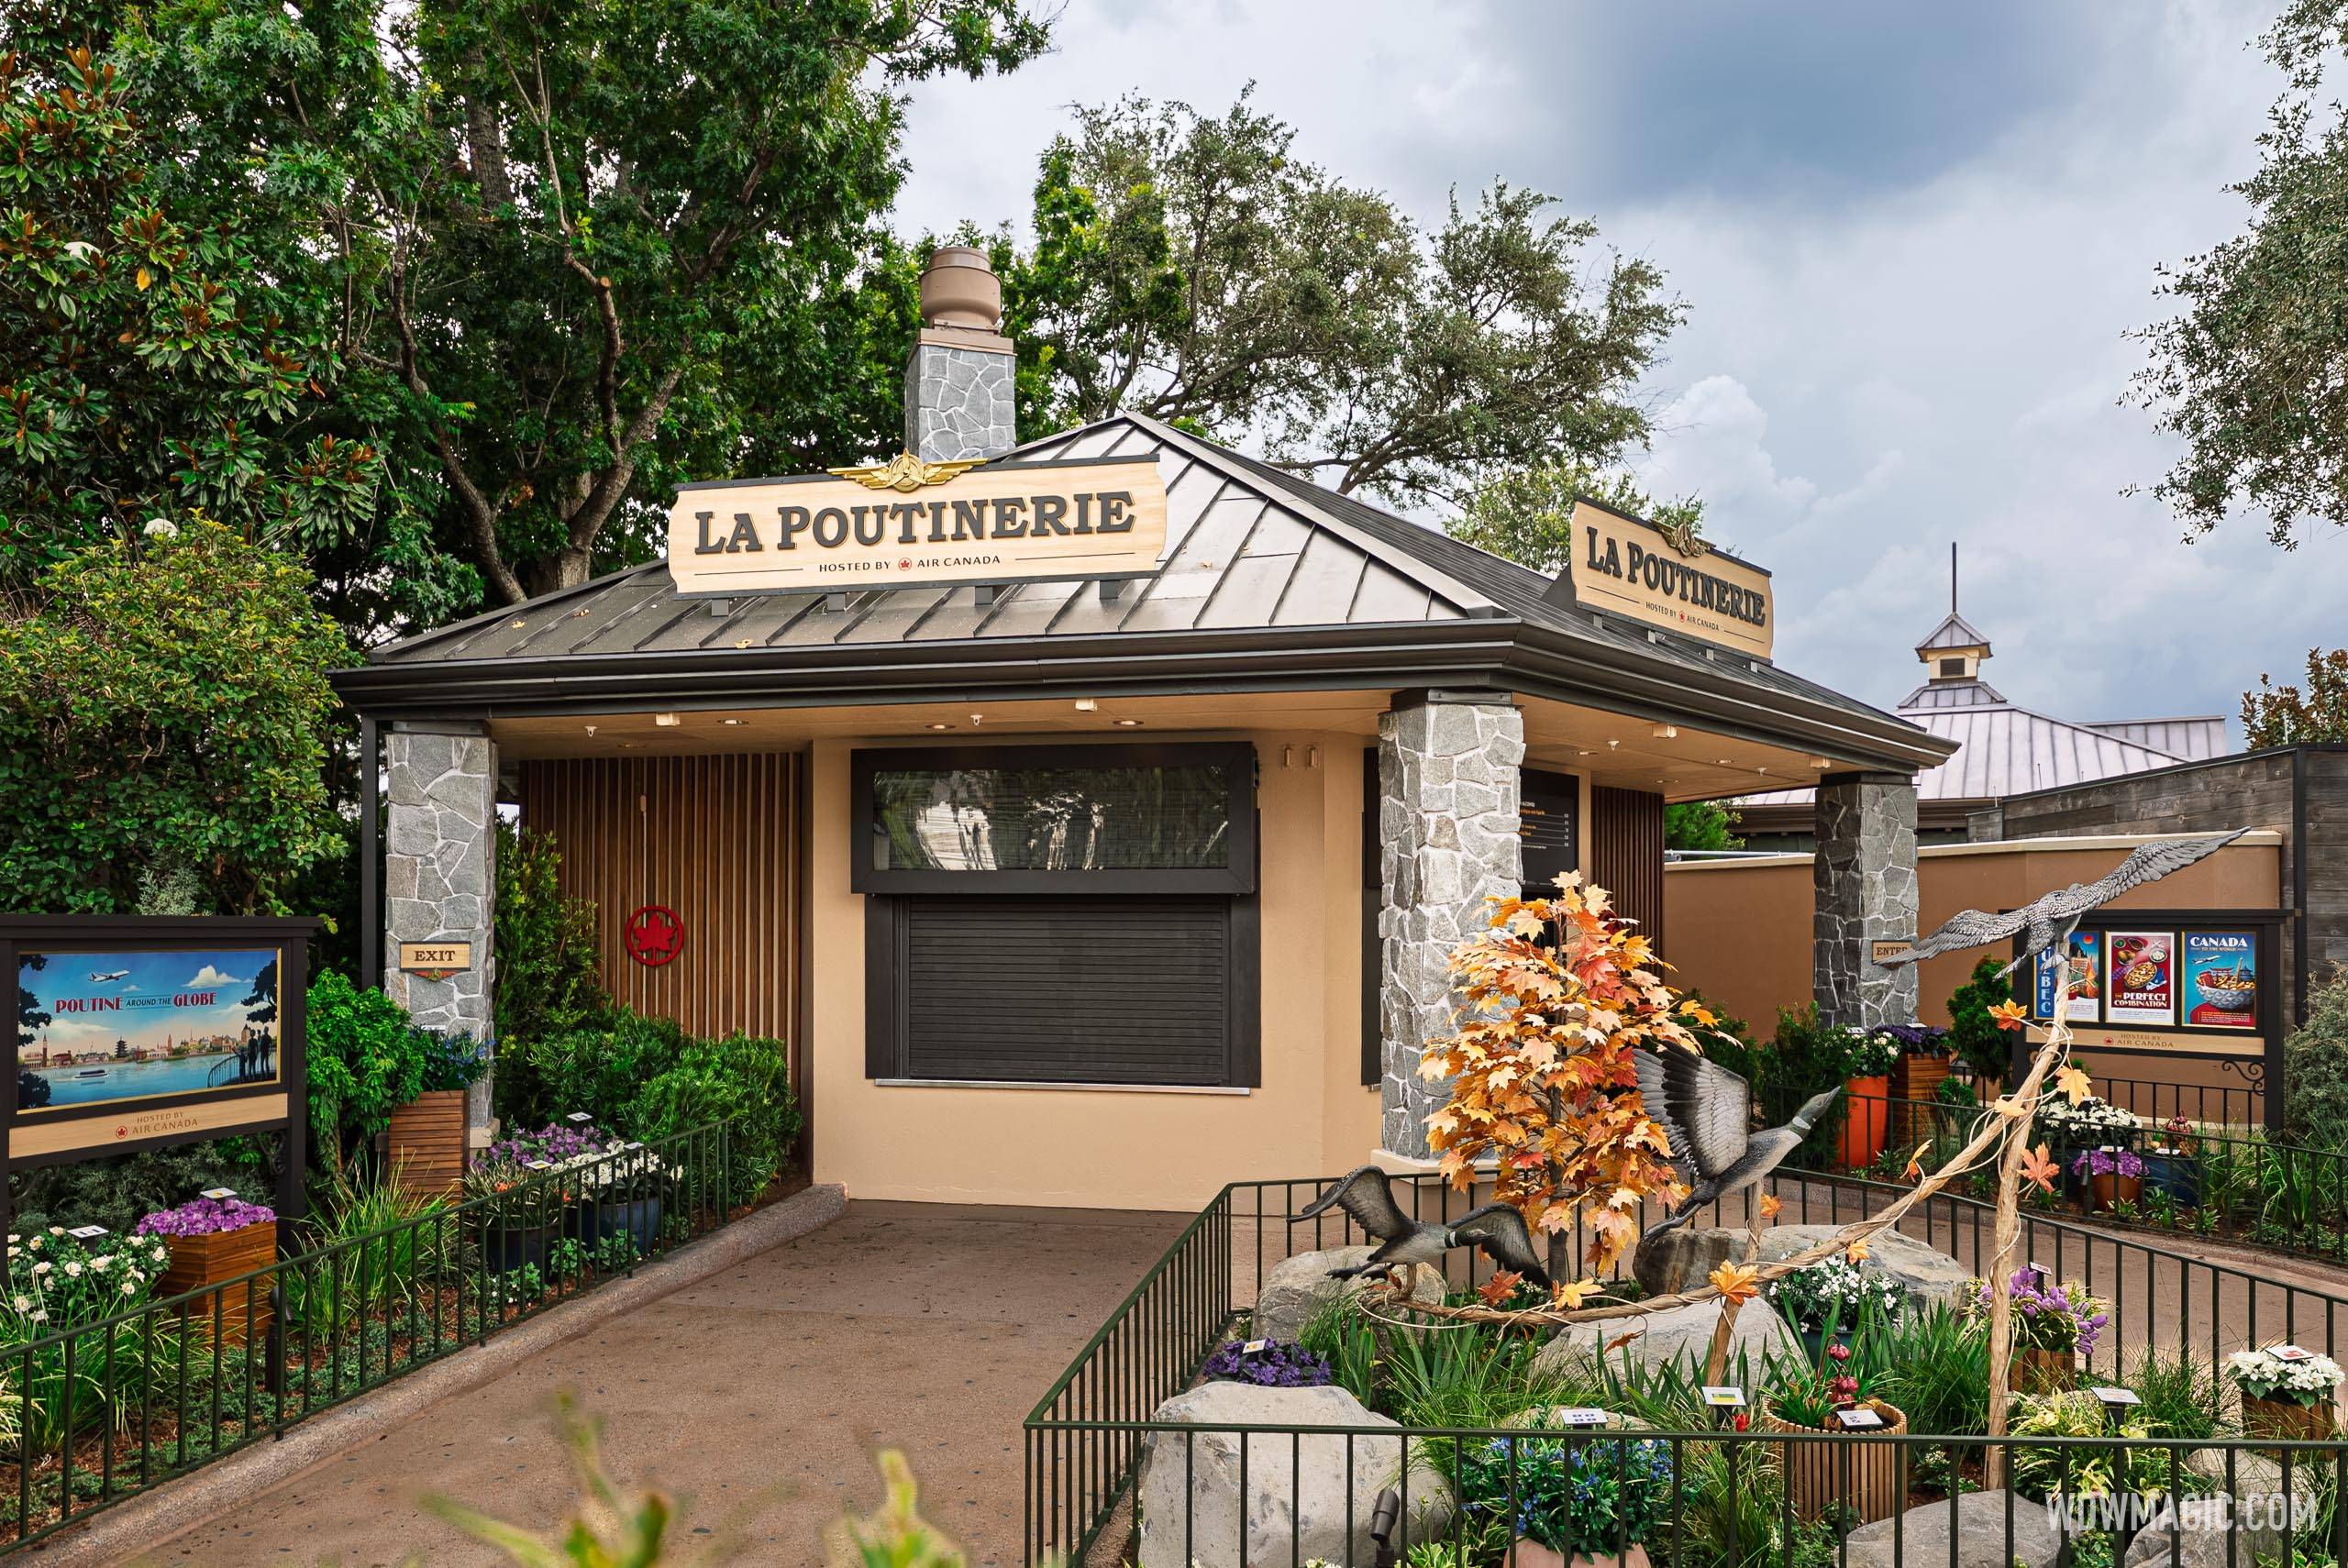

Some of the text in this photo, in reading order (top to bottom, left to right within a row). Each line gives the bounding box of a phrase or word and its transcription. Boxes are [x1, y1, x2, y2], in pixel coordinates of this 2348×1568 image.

[694, 491, 1136, 555] LA POUTINERIE
[819, 560, 892, 573] HOSTED BY
[917, 555, 1001, 569] AIR CANADA
[1587, 525, 1767, 628] LA POUTINERIE
[1645, 601, 1678, 618] HOSTED BY
[1686, 615, 1720, 632] AIR CANADA
[2189, 936, 2248, 947] CANADA
[414, 950, 455, 961] EXIT
[2041, 945, 2051, 1013] UBEC
[55, 992, 216, 1013] POUTINE AROUND THE GLOBE
[2114, 999, 2167, 1008] COMBINATION
[2123, 992, 2167, 1001] PERFECT
[2134, 1040, 2174, 1048] CANADA
[137, 1110, 184, 1123] HOSTED BY
[131, 1118, 198, 1135] AIR CANADA
